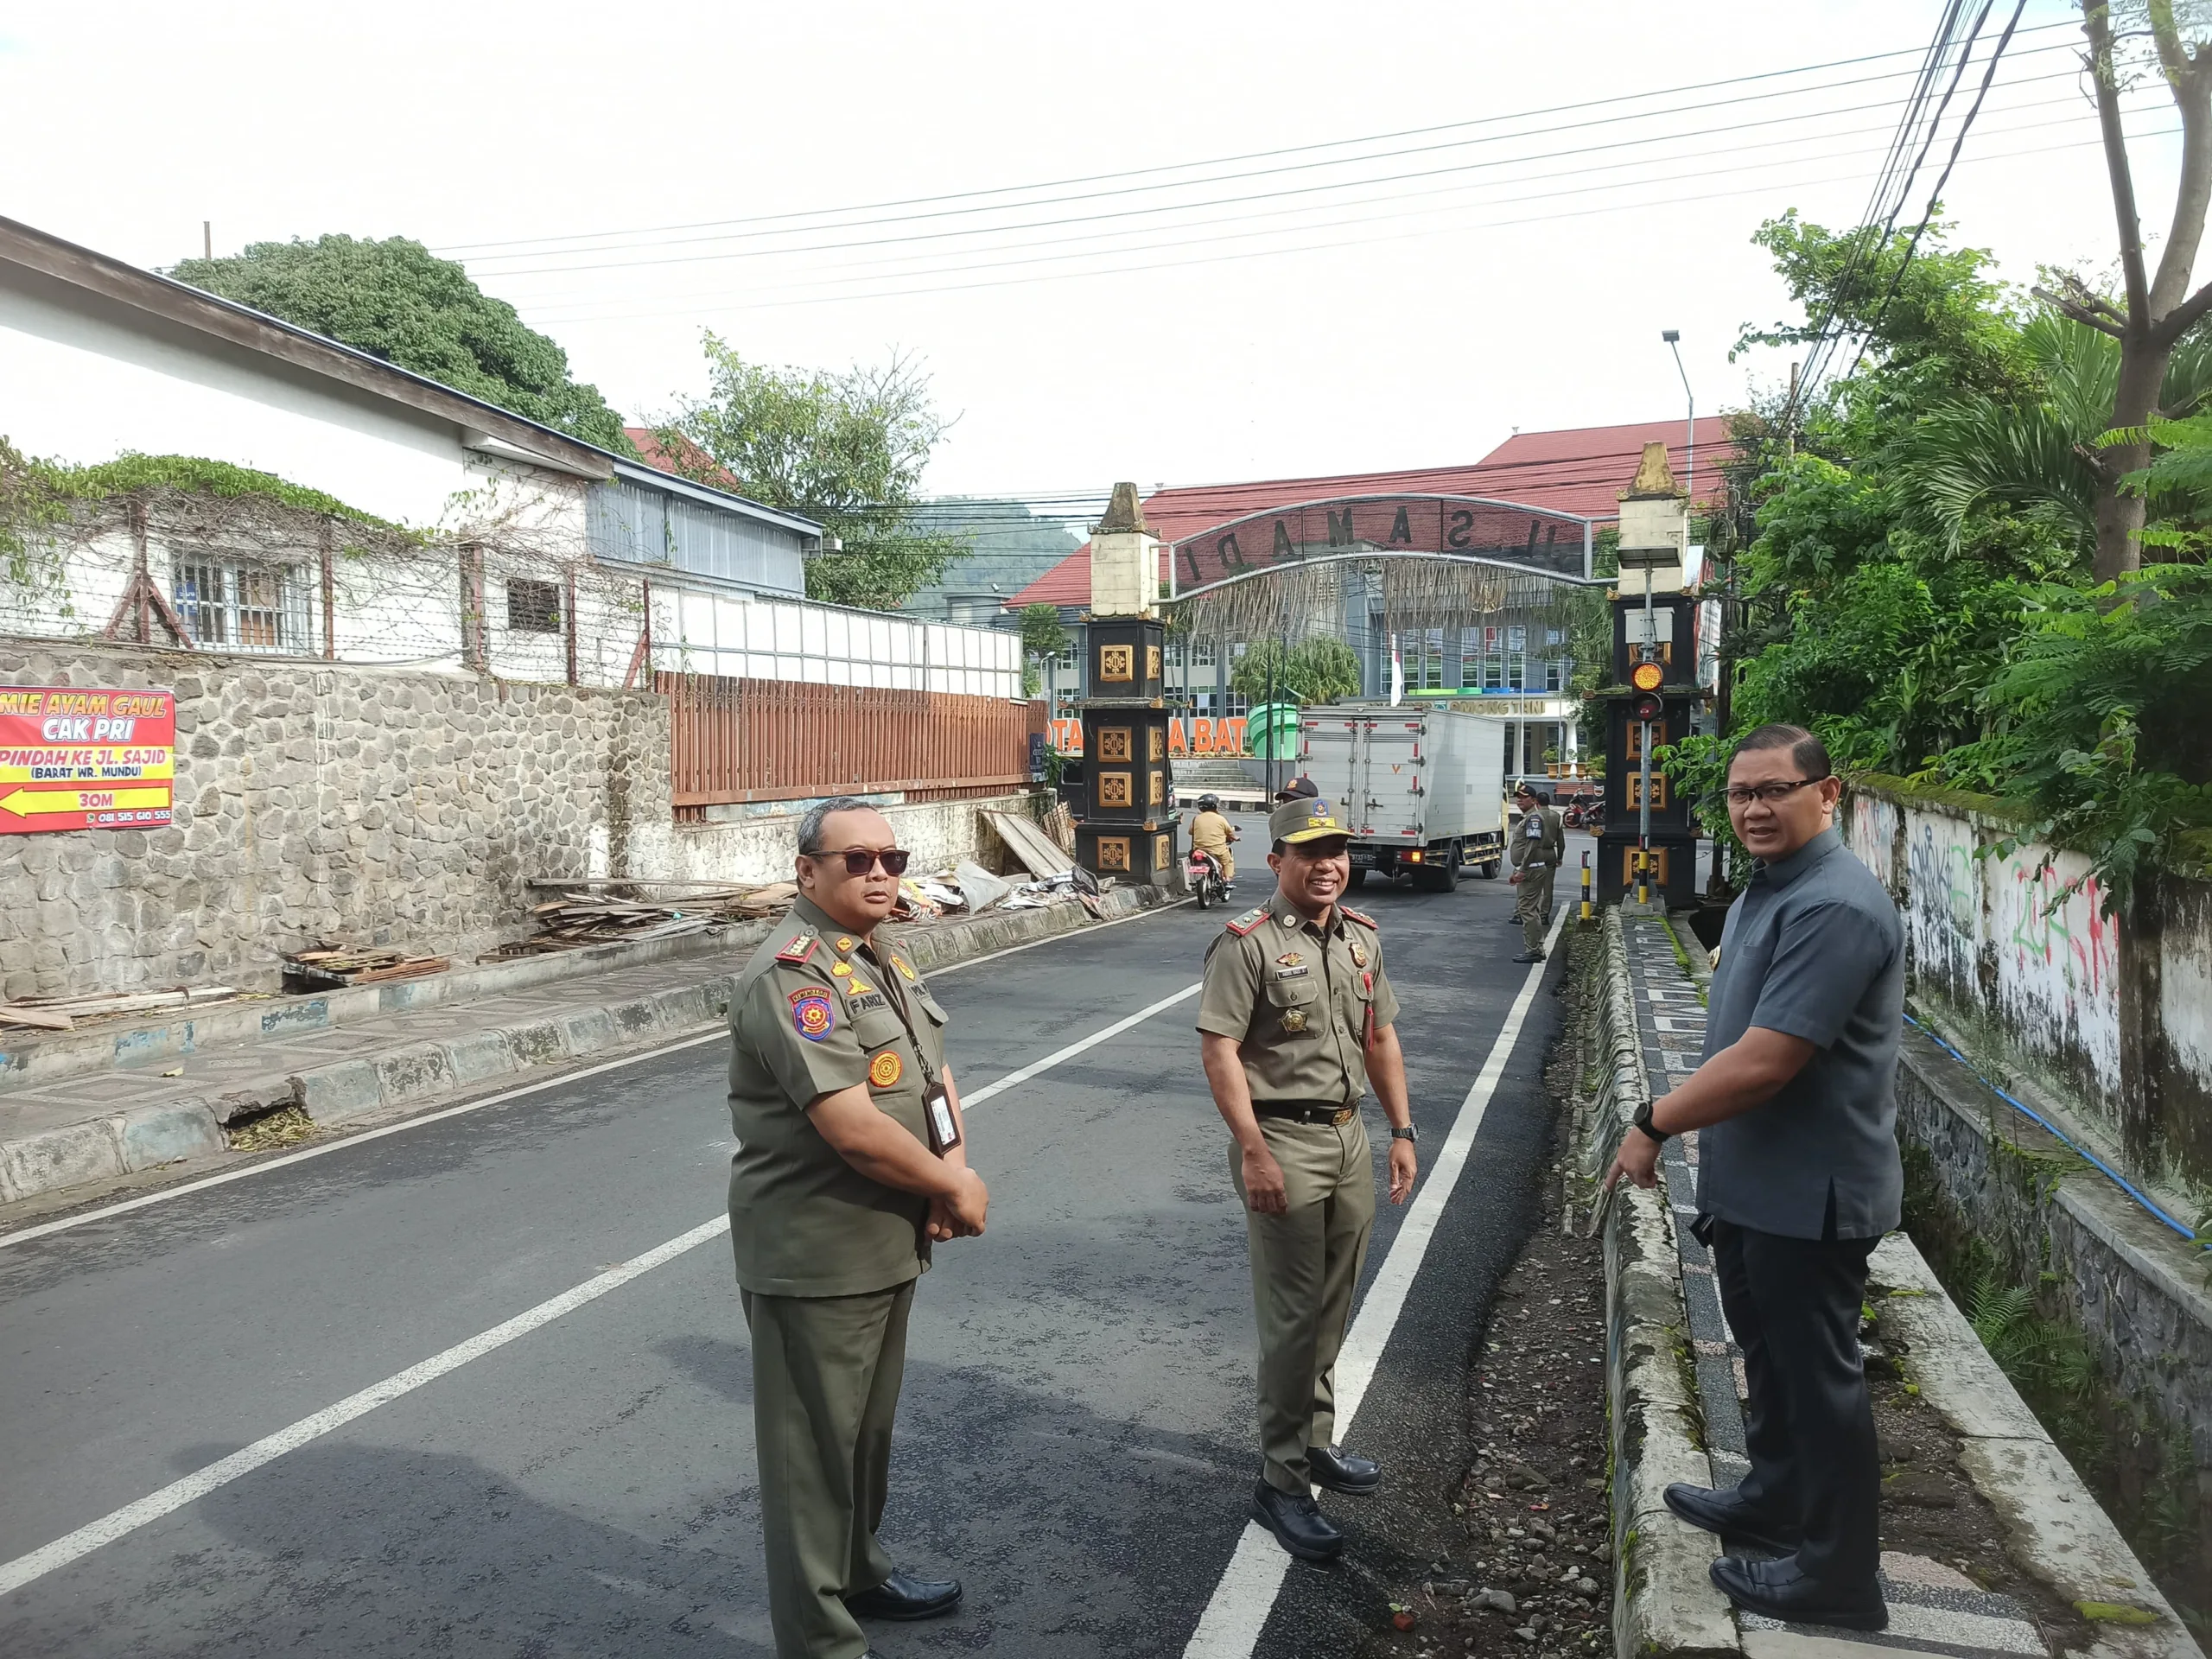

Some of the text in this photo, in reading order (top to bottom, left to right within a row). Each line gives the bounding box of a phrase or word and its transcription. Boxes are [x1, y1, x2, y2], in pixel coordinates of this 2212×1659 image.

[0, 692, 166, 717] MIE AYAM GAUL
[42, 718, 135, 741] CAK PRI
[1046, 718, 1084, 752] TA
[1195, 718, 1248, 753] BAT
[0, 749, 166, 766] PINDAH KE JL. SAJID
[31, 766, 142, 779] (BARAT WR. MUNDU)
[78, 792, 113, 808] 30M
[98, 810, 172, 823] 081 515 610 555
[849, 994, 887, 1014] FARIZ
